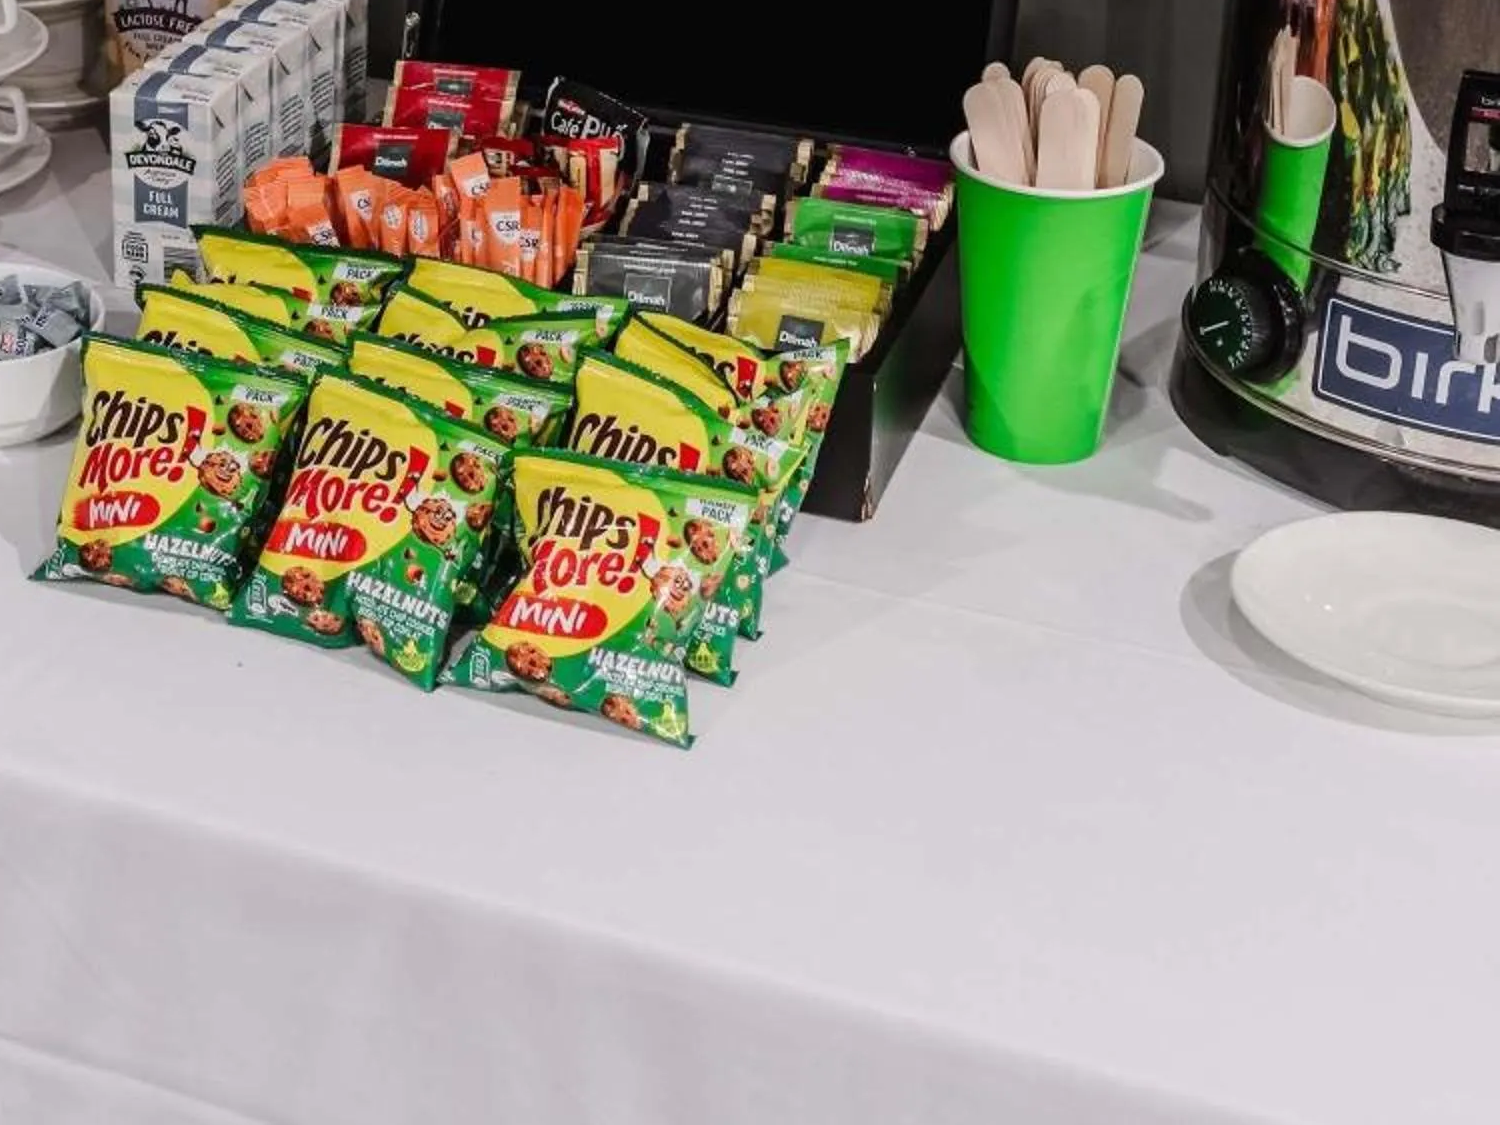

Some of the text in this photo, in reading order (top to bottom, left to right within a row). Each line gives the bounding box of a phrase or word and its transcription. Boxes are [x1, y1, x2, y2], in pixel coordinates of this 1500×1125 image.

[121, 13, 195, 34] LACTOSE FRE
[128, 154, 194, 172] DEVONDALE
[142, 203, 180, 220] CREAM
[149, 190, 173, 205] FULL
[496, 220, 520, 232] CSR
[627, 289, 666, 307] Dilmah
[779, 330, 819, 349] Dilmah
[86, 390, 185, 449] Chips
[77, 405, 207, 490] More!
[297, 416, 408, 482] Chips
[284, 444, 431, 524] More!
[88, 498, 141, 529] MINI
[701, 506, 732, 524] PACK
[284, 522, 348, 556] MINI
[346, 570, 450, 630] HAZELNUTS
[509, 597, 588, 636] MINI
[588, 646, 684, 684] HAZELNUT
